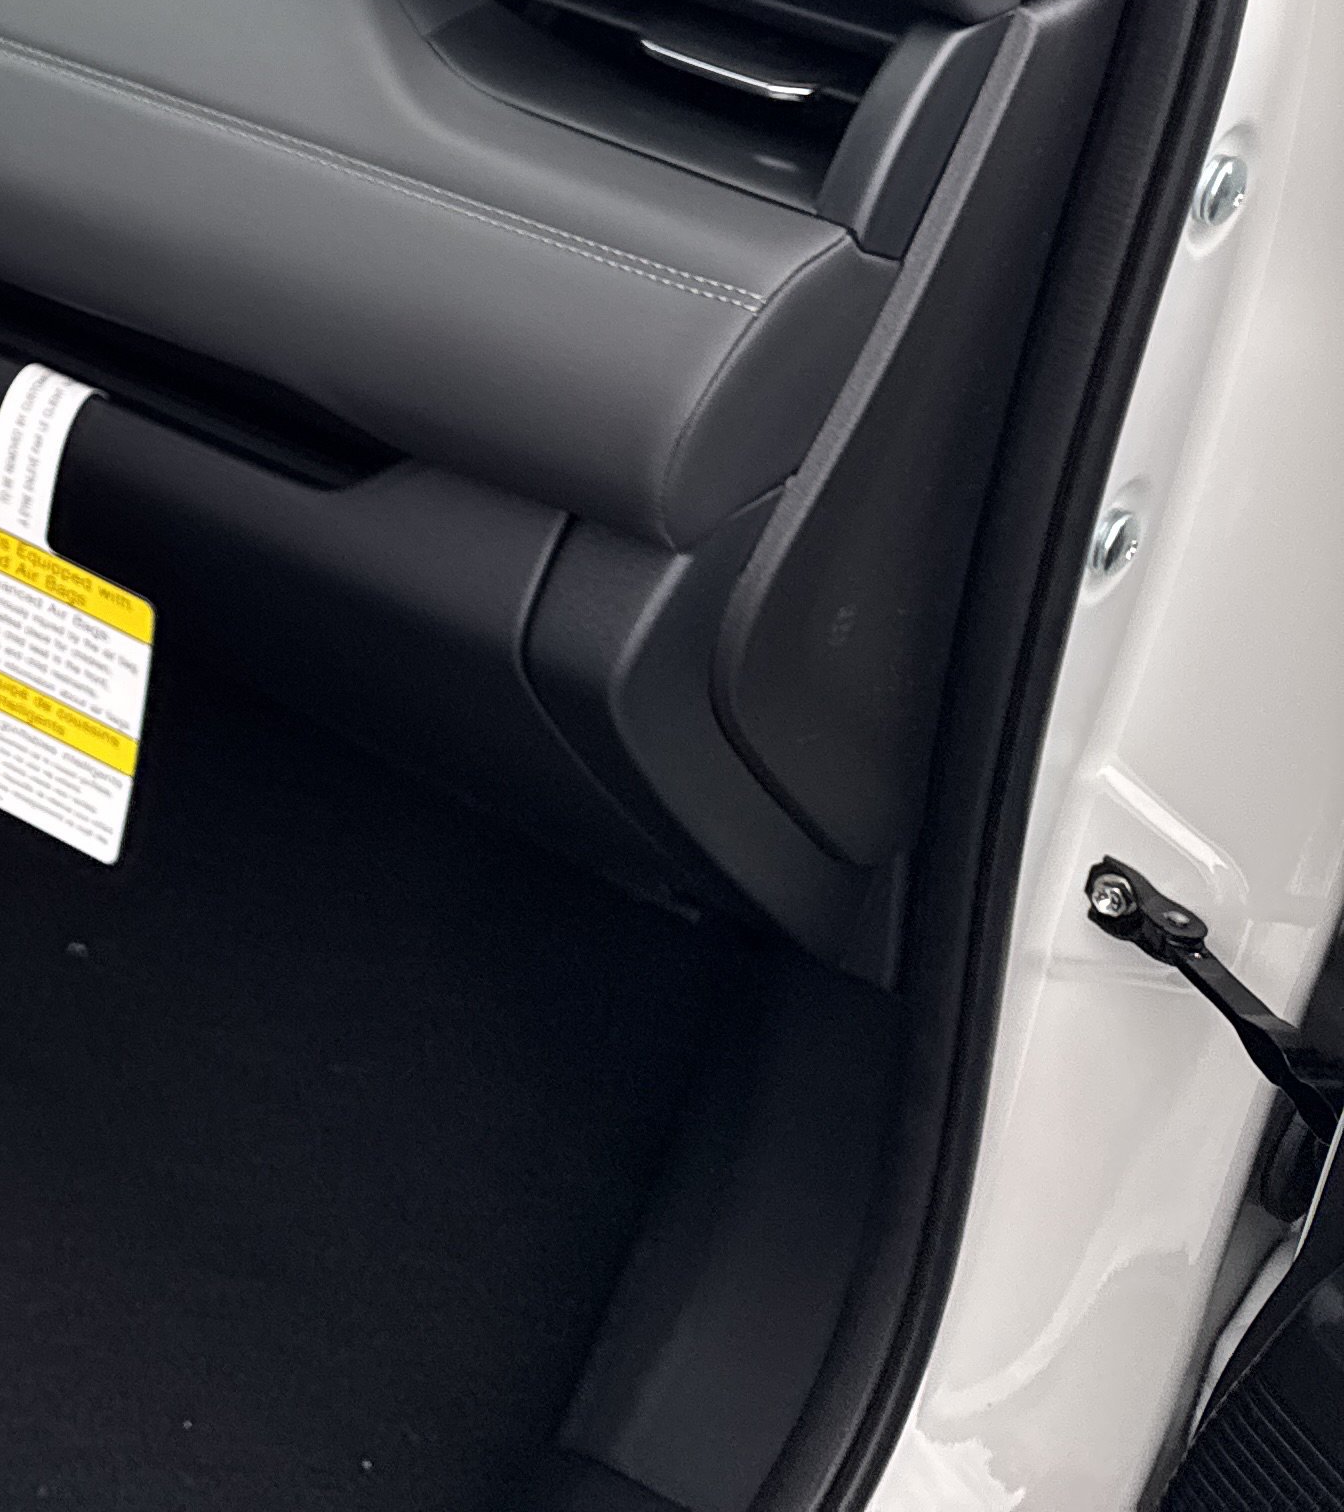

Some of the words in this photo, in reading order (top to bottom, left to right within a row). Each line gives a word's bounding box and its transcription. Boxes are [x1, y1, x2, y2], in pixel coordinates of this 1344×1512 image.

[14, 542, 93, 593] Equipped
[96, 584, 133, 612] with
[15, 560, 39, 583] Air
[43, 573, 88, 612] Bags
